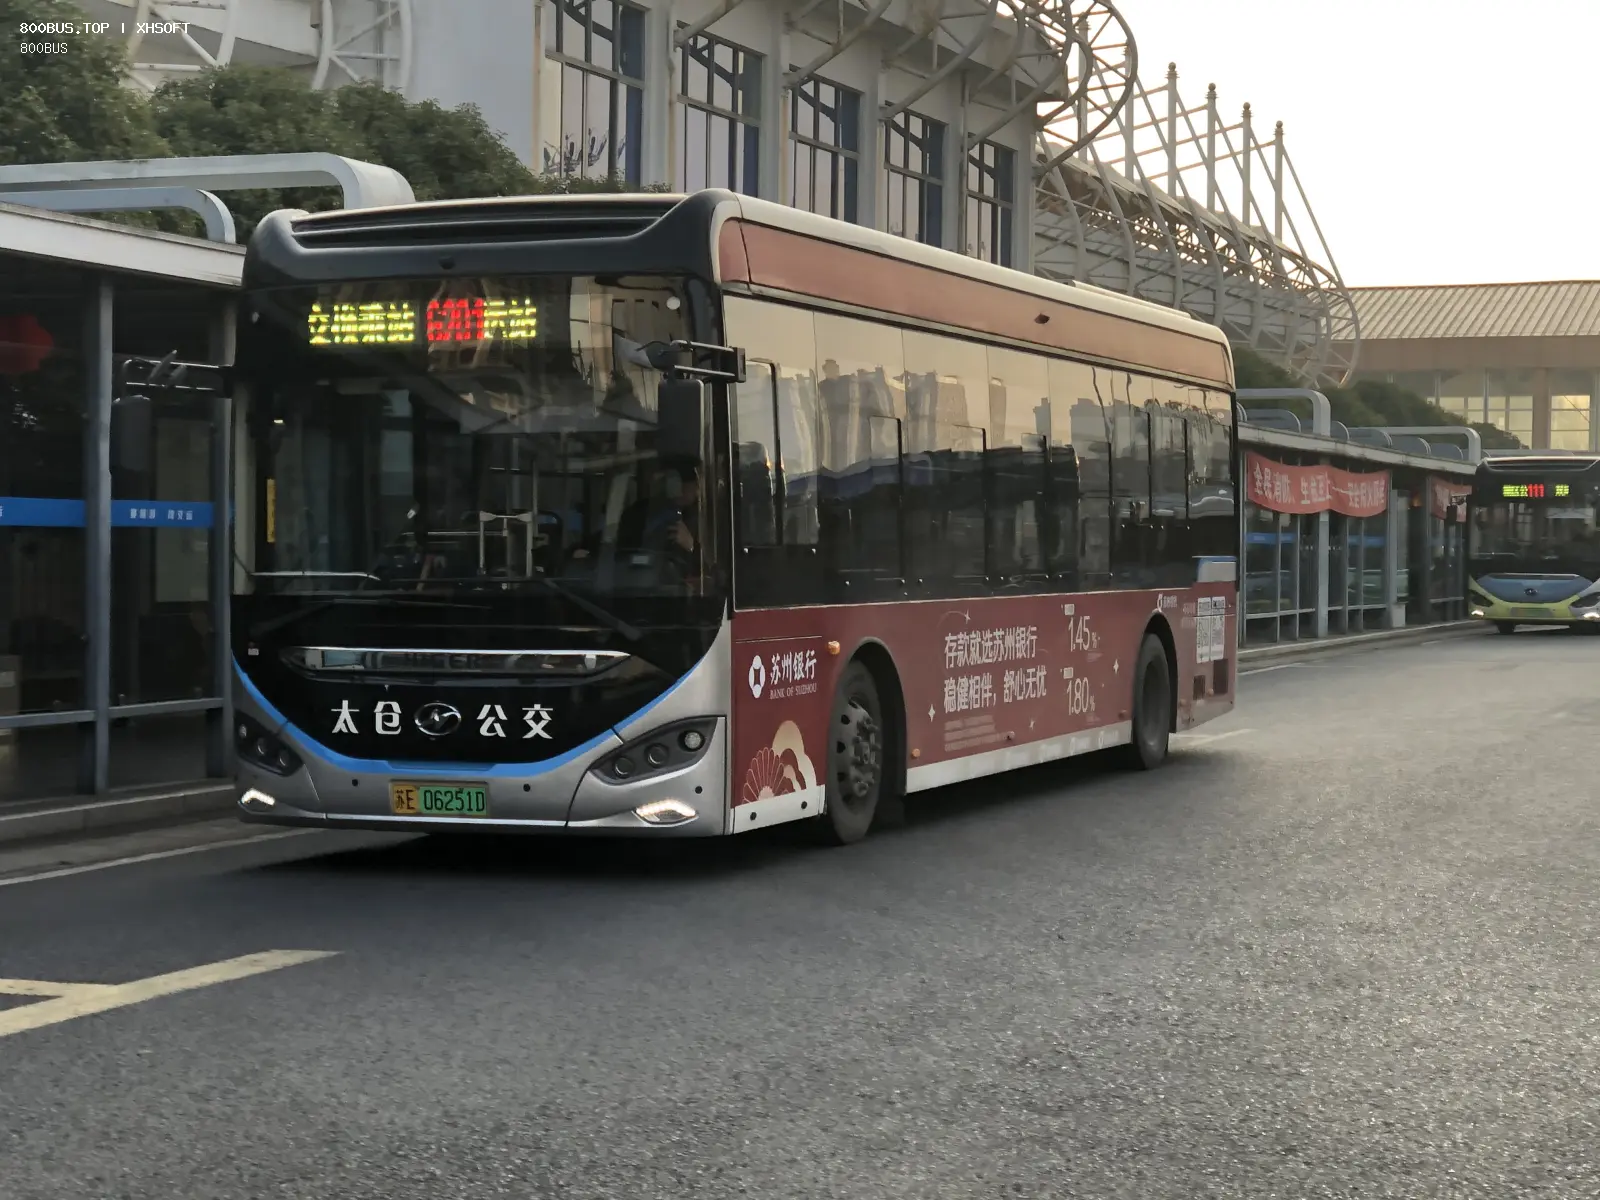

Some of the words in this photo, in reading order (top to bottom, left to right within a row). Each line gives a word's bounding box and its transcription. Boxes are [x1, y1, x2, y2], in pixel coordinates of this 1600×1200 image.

[944, 625, 1038, 669] 存款就选苏州银行
[770, 649, 817, 685] 苏州银行
[769, 687, 785, 700] BANK
[786, 686, 794, 697] OF
[795, 683, 817, 696] SUZHOU
